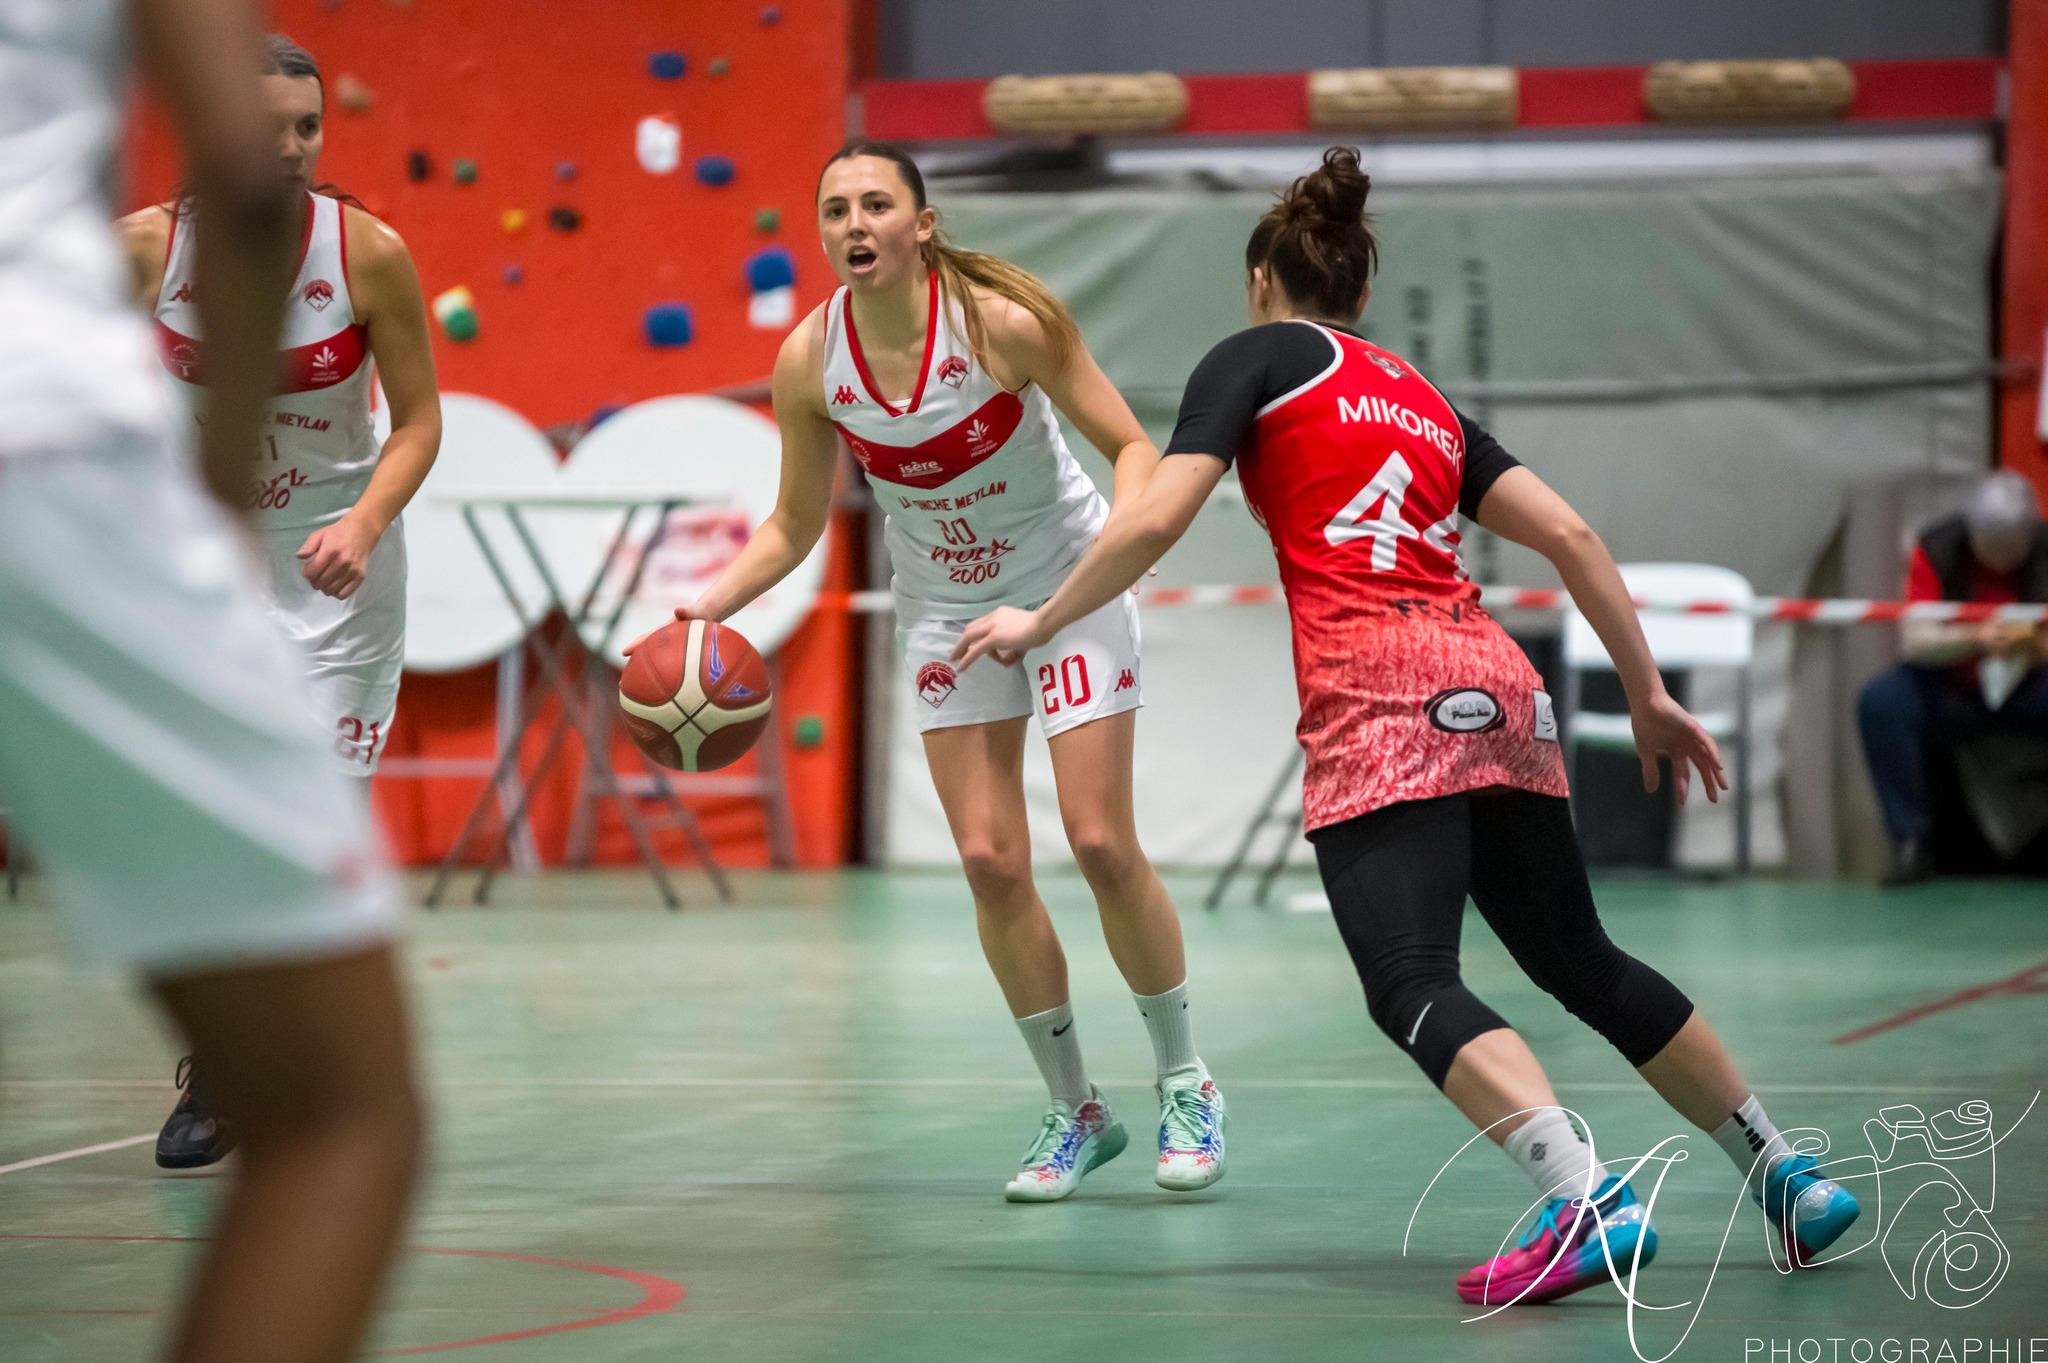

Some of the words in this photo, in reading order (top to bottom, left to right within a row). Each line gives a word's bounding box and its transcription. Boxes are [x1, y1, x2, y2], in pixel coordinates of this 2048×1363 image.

[275, 411, 331, 432] MEYLAN
[898, 460, 938, 474] isère
[954, 480, 1007, 510] MEYLAN
[949, 561, 1001, 585] 2000
[1038, 653, 1092, 716] 20
[336, 716, 379, 765] 21
